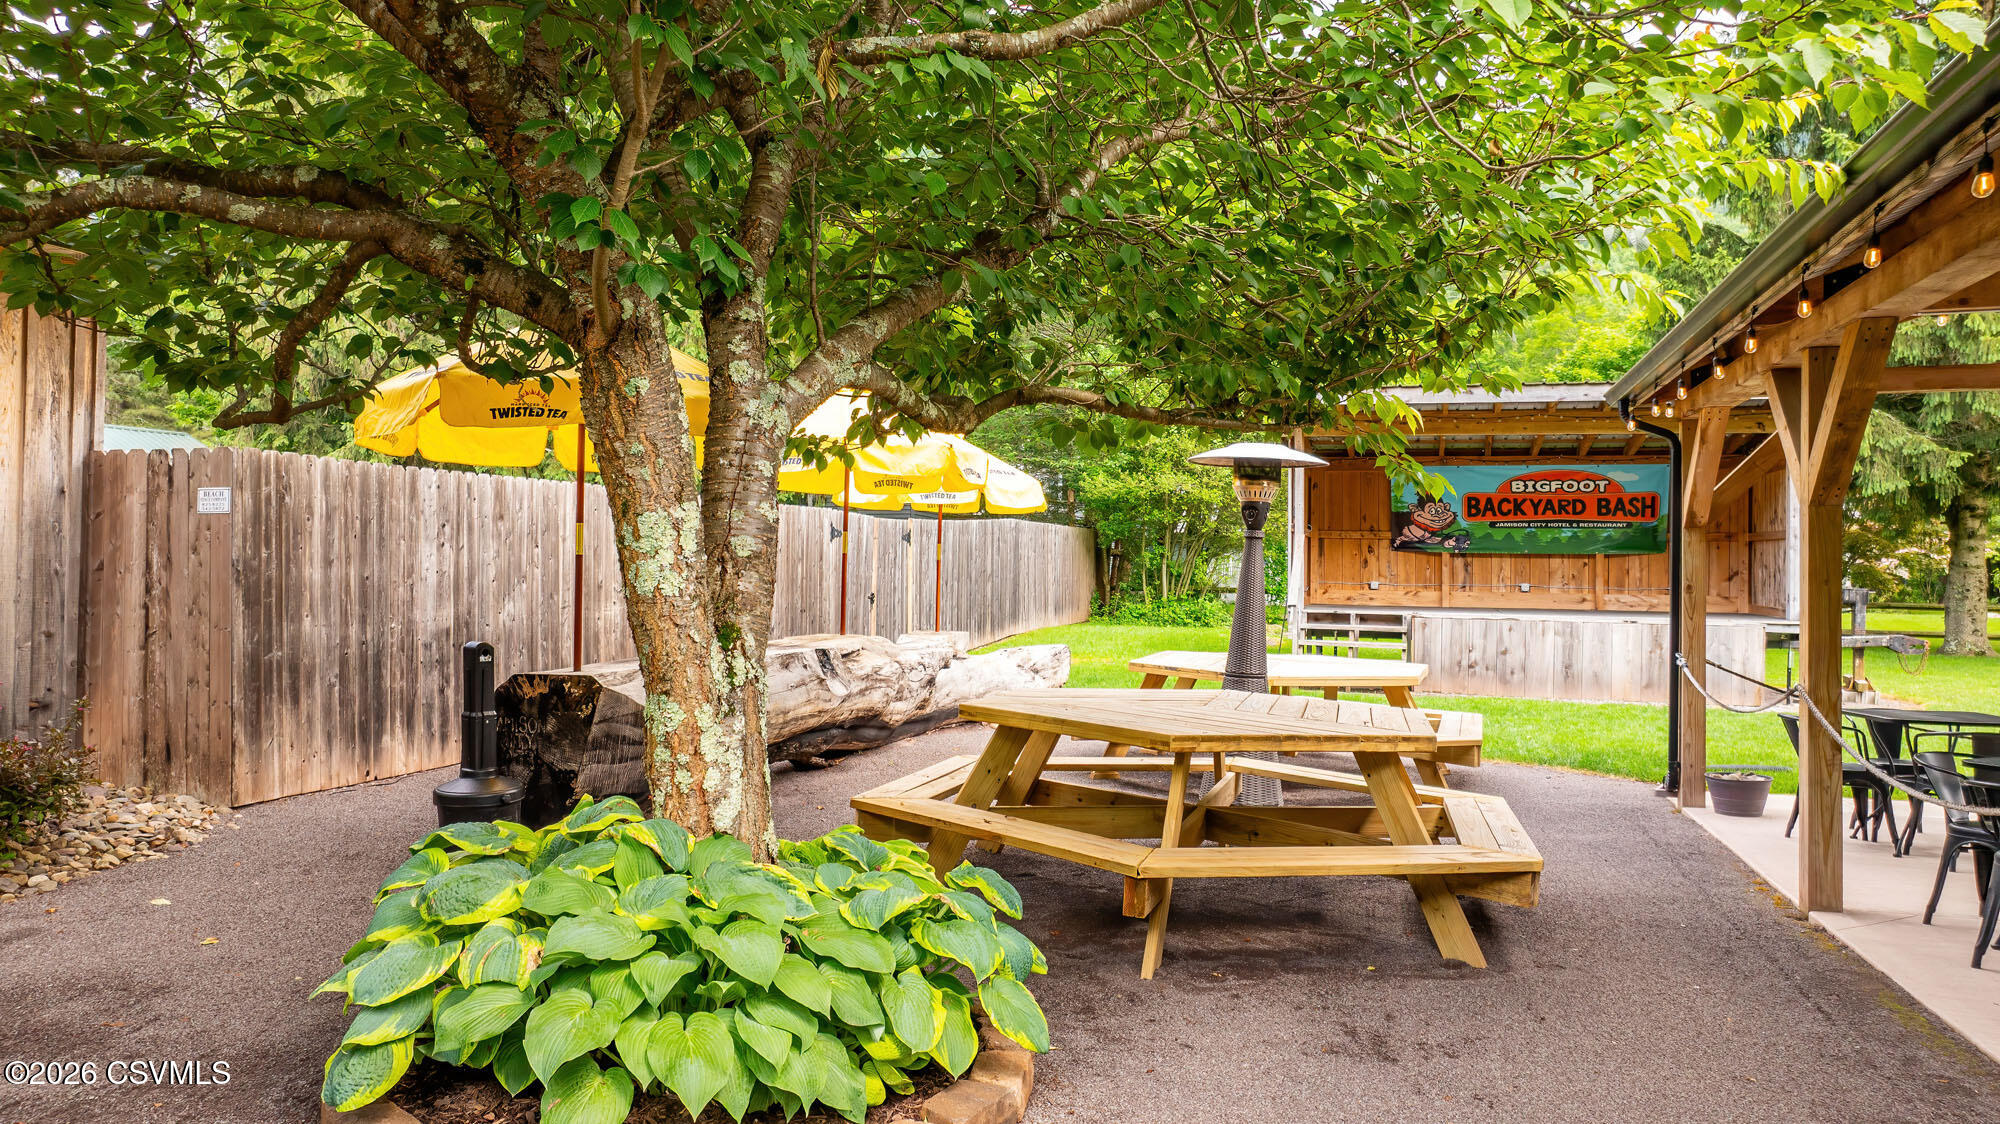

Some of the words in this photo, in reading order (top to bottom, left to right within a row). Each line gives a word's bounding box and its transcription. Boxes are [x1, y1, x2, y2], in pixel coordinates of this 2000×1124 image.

[489, 406, 546, 420] TWISTED
[546, 408, 568, 420] TEA
[1510, 479, 1610, 493] BIGFOOT
[1466, 495, 1587, 518] BACKYARD
[1596, 495, 1656, 518] BASH
